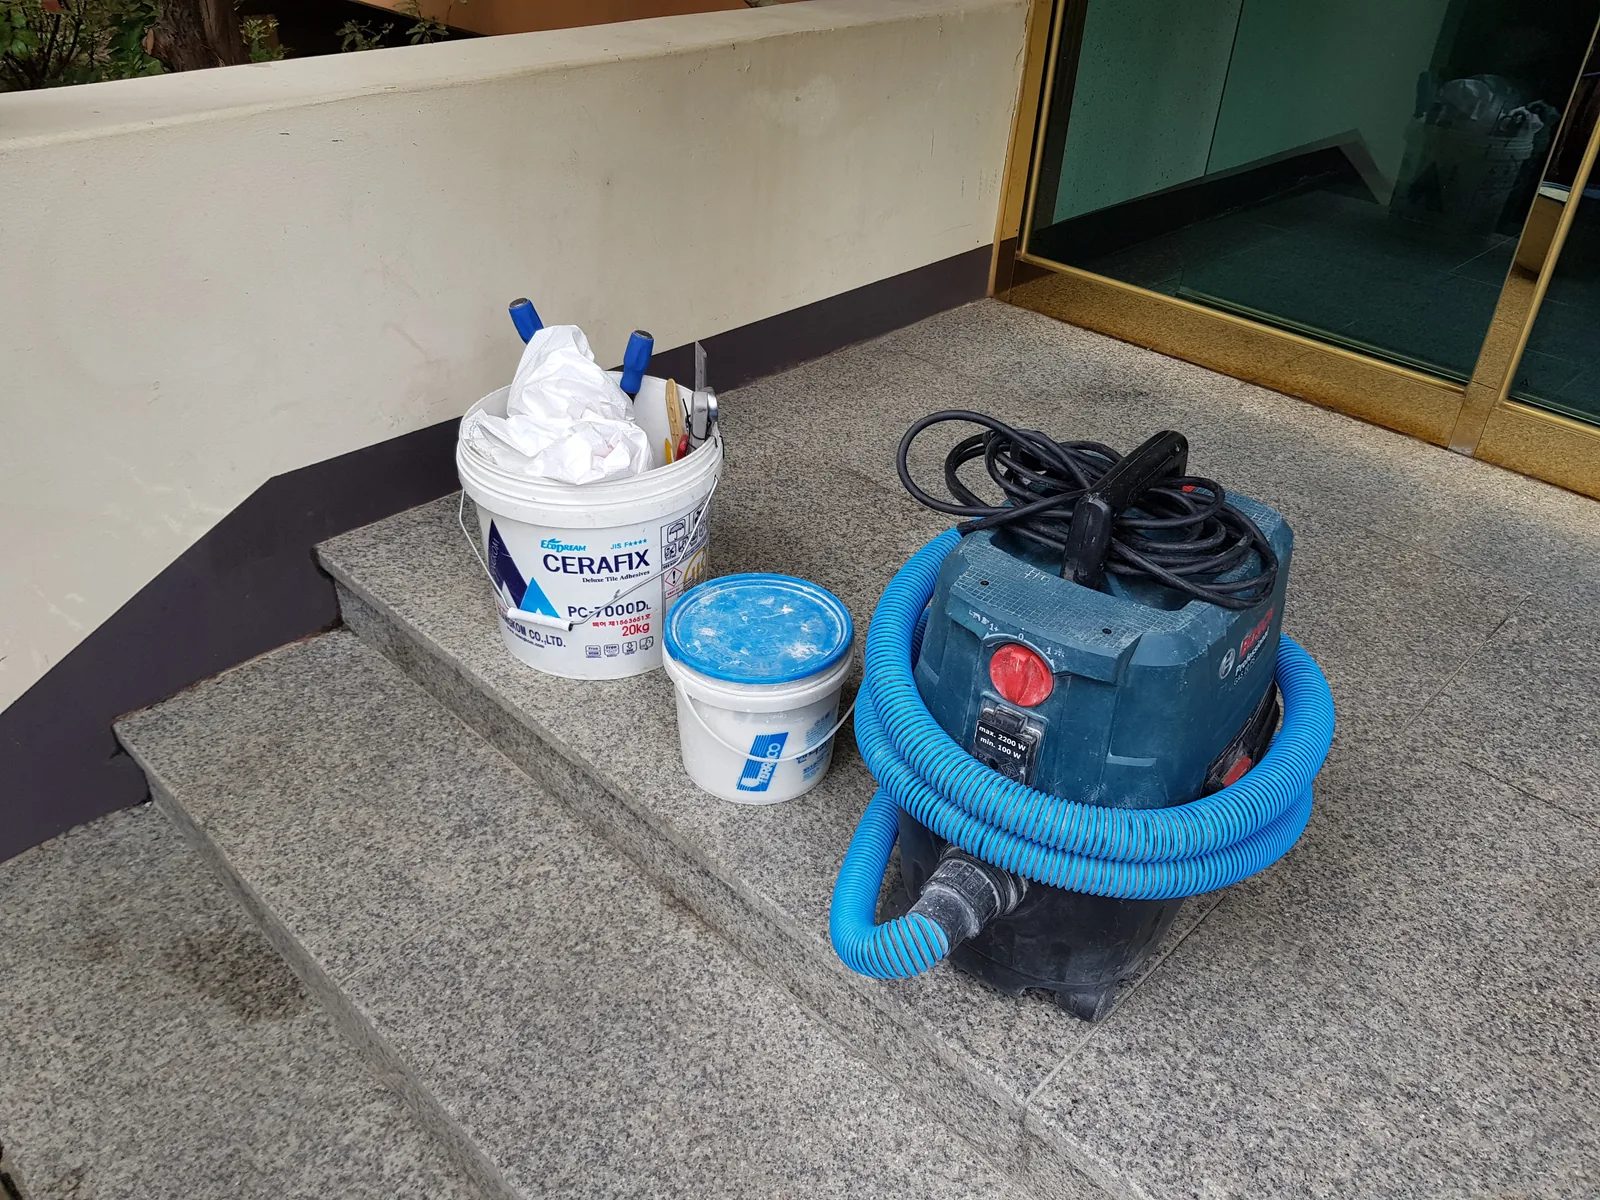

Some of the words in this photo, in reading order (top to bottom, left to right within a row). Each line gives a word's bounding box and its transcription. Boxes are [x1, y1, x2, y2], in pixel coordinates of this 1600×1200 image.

[542, 549, 651, 575] CERAFIX
[619, 570, 651, 580] Adhesives
[622, 623, 650, 637] 20kg
[978, 725, 997, 739] max.
[997, 733, 1016, 747] 2200
[1018, 741, 1027, 751] W
[980, 736, 996, 749] min.
[997, 744, 1012, 755] 100
[1013, 750, 1021, 759] W
